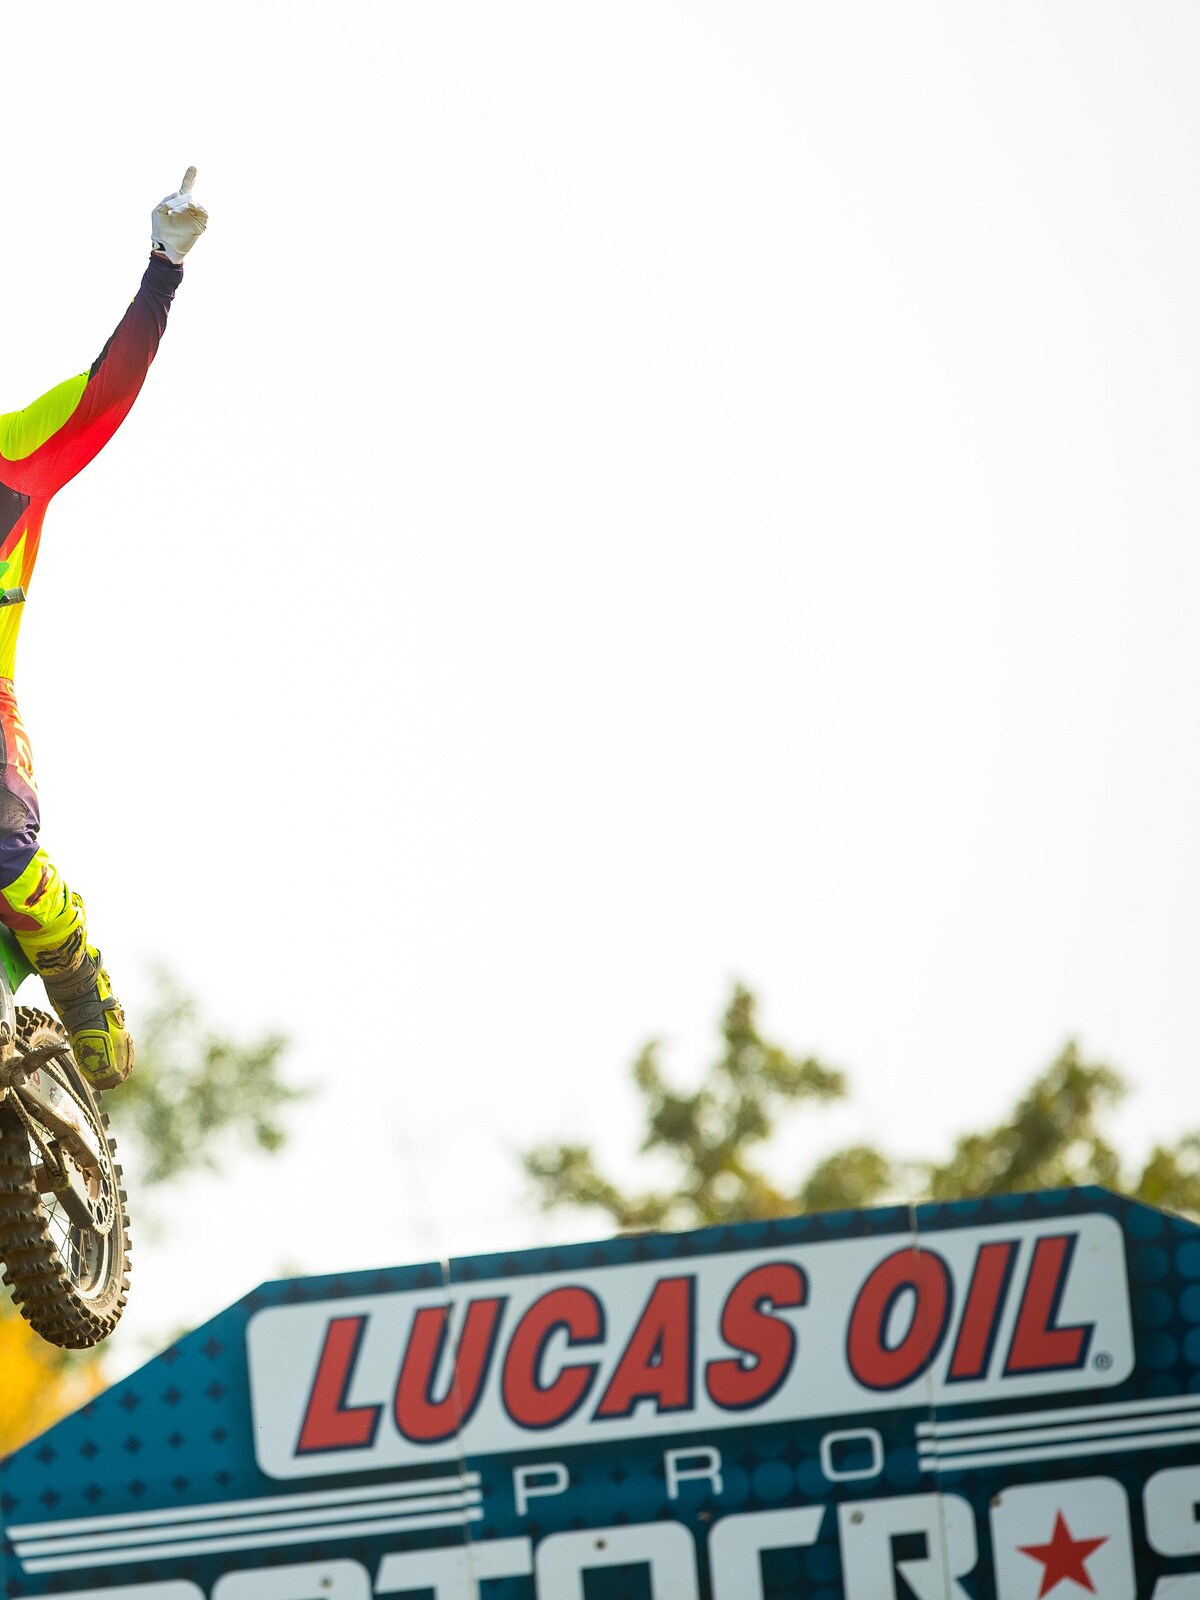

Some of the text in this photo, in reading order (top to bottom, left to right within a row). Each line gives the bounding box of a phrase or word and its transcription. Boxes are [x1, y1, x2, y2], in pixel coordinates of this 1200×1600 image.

[293, 1232, 1097, 1459] LUCAS OIL
[512, 1426, 886, 1517] PRO
